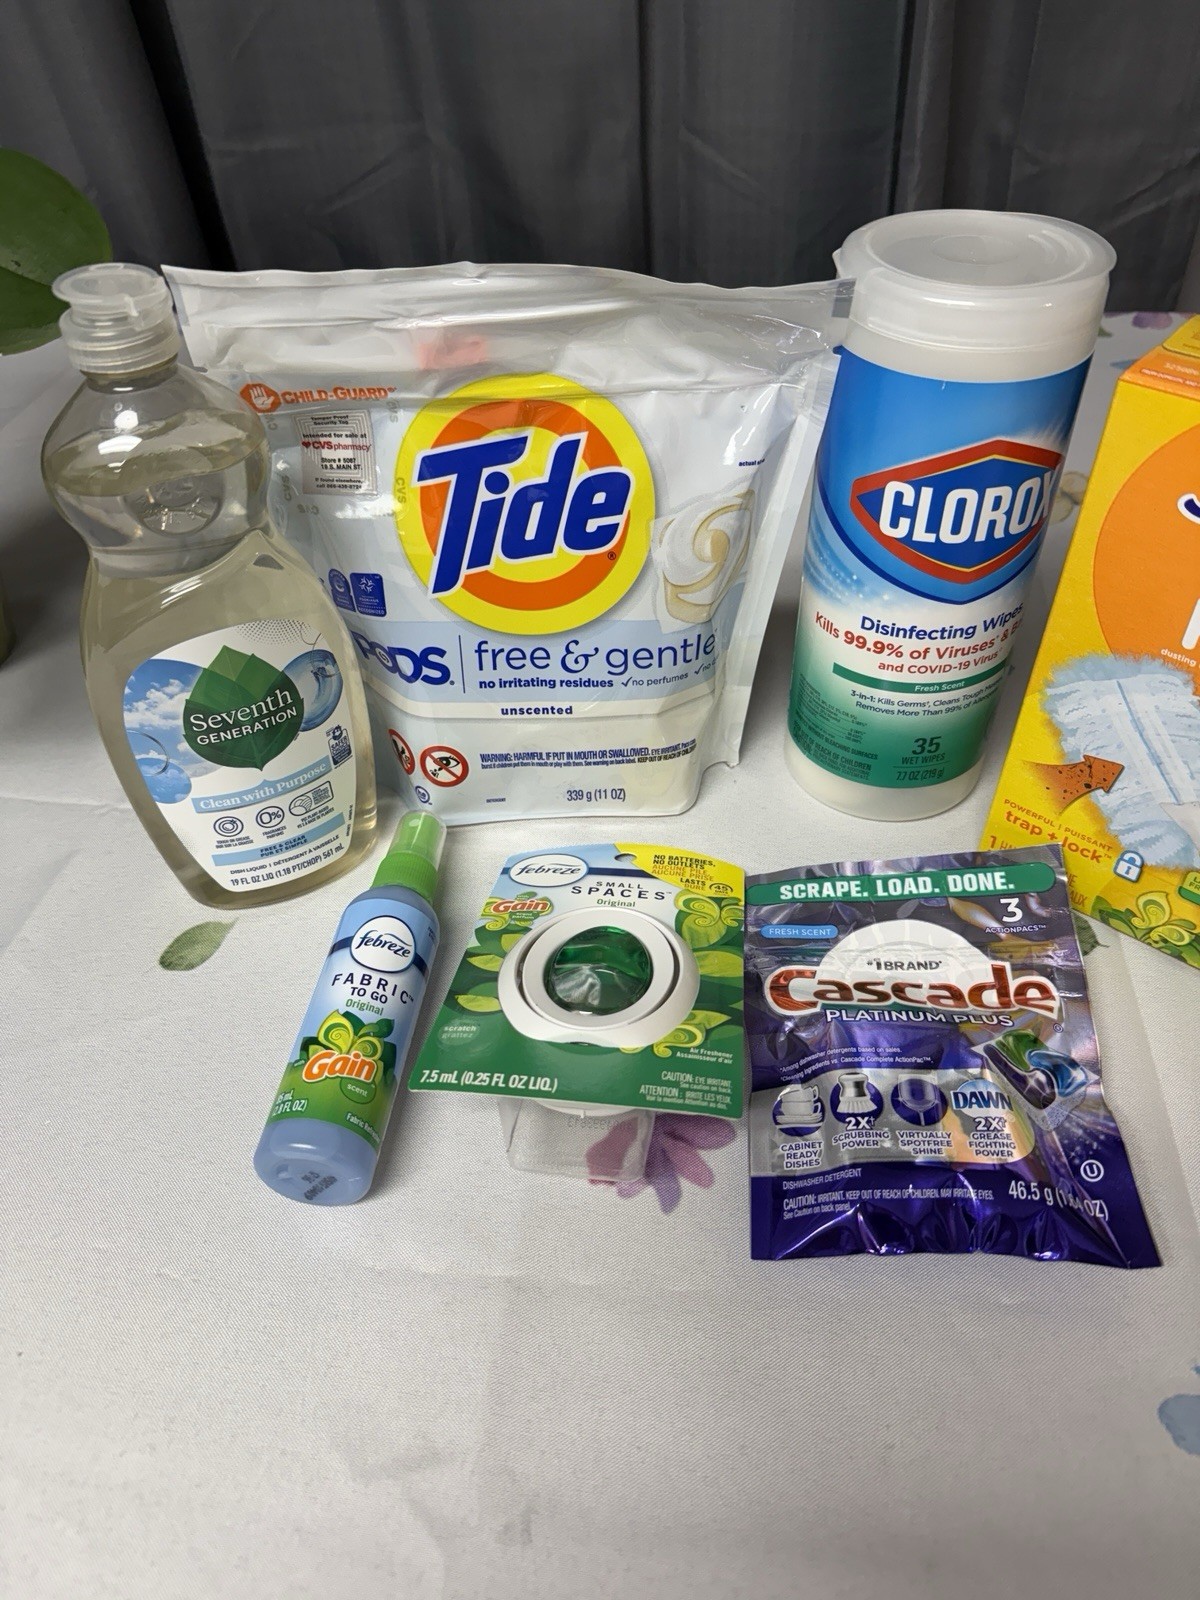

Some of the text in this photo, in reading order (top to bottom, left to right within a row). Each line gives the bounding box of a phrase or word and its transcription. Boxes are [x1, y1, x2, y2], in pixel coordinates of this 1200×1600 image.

[417, 434, 631, 594] Tide
[879, 471, 1052, 544] CLOROX
[860, 602, 1023, 640] Disinfecting Wipes
[815, 611, 931, 660] Kills 99.9% of
[474, 639, 551, 671] free
[560, 639, 600, 674] &
[605, 633, 716, 676] gentle
[1160, 648, 1197, 667] dusting
[878, 662, 906, 671] and
[908, 660, 970, 675] COVID-19
[478, 679, 495, 689] no
[498, 678, 557, 690] irritating
[560, 678, 614, 689] residues
[646, 674, 689, 688] perfumes
[915, 681, 966, 692] Fresh Scent
[850, 689, 961, 708] 3-in-1: Kills Cleans
[189, 689, 294, 733] Seventh
[501, 705, 573, 716] unscented
[855, 701, 963, 716] Removes More Than 99%
[196, 706, 298, 746] GENERATION
[912, 736, 942, 755] 35
[480, 747, 650, 763] WARNING: HARMFUL IF PUT IN MOUTH OR SWALLOWED.
[901, 753, 946, 765] WET WIPES
[908, 770, 920, 780] OZ
[200, 762, 327, 811] Clean with Purpose
[566, 788, 626, 802] 339 g (11 OZ)
[259, 811, 282, 825] 0%
[1003, 798, 1114, 852] POWERFUL PUISSANT
[1004, 810, 1043, 836] trap
[260, 834, 306, 854] FREE CLEAR
[285, 838, 308, 852] SIMPLE
[246, 864, 268, 872] LIQUID
[274, 850, 308, 867] DÉTERGENT
[314, 834, 340, 851] VAISSELLE
[230, 843, 345, 887] 19 FL OZ LIQ (1.18 PT/CHOP) 561 mL
[667, 860, 705, 870] OUTLETS
[668, 855, 716, 867] BATTERIES,
[518, 861, 582, 877] febreze
[651, 870, 715, 882] AUCUNE PRISE
[652, 865, 687, 873] AUCUNE
[595, 881, 643, 890] SMALL
[680, 878, 706, 886] LASTS
[779, 871, 1015, 901] SCRAPE. LOAD. DONE.
[570, 885, 666, 901] SPACES
[491, 899, 551, 914] Gain
[596, 898, 636, 909] Original
[1000, 898, 1023, 923] 3
[768, 927, 832, 937] FRESH SCENT
[354, 929, 412, 960] febreze
[332, 972, 409, 1005] FABRIC
[350, 987, 389, 1004] TO GO
[768, 963, 1057, 1014] Cascade
[345, 998, 385, 1016] Original
[825, 1008, 1014, 1028] PLATINUM PLUS
[442, 1030, 474, 1040] grattez
[444, 1024, 477, 1033] scratch
[676, 1051, 717, 1062] Assainisseur
[700, 1048, 733, 1059] Freshener
[827, 1047, 857, 1055] detergents
[302, 1049, 376, 1082] Gain
[420, 1070, 558, 1094] 7.5 mL (0.25 FL OZ LIQ.)
[661, 1071, 706, 1085] CAUTION: EYE
[346, 1082, 368, 1097] scent
[639, 1084, 679, 1098] ATTENTION
[952, 1089, 1012, 1112] DAWN
[346, 1112, 365, 1129] Fabric
[832, 1130, 891, 1144] SCRUBBING
[897, 1130, 952, 1140] VIRTUALLY
[971, 1131, 1013, 1142] GREASE
[779, 1141, 823, 1154] CABINET
[841, 1138, 880, 1149] POWER
[899, 1138, 954, 1148] SPOTFREE
[968, 1140, 1017, 1151] FIGHTING
[785, 1150, 819, 1162] READY
[911, 1146, 944, 1156] SHINE
[974, 1148, 1014, 1158] POWER
[783, 1158, 821, 1170] DISHES
[783, 1168, 862, 1191] DISHWASHER DETERGENT
[784, 1195, 817, 1211] CAUTION:
[846, 1190, 860, 1202] KEEP
[861, 1190, 873, 1200] OUT
[882, 1188, 901, 1200] REACH
[1008, 1179, 1041, 1200] 46.5
[1044, 1187, 1054, 1206] g
